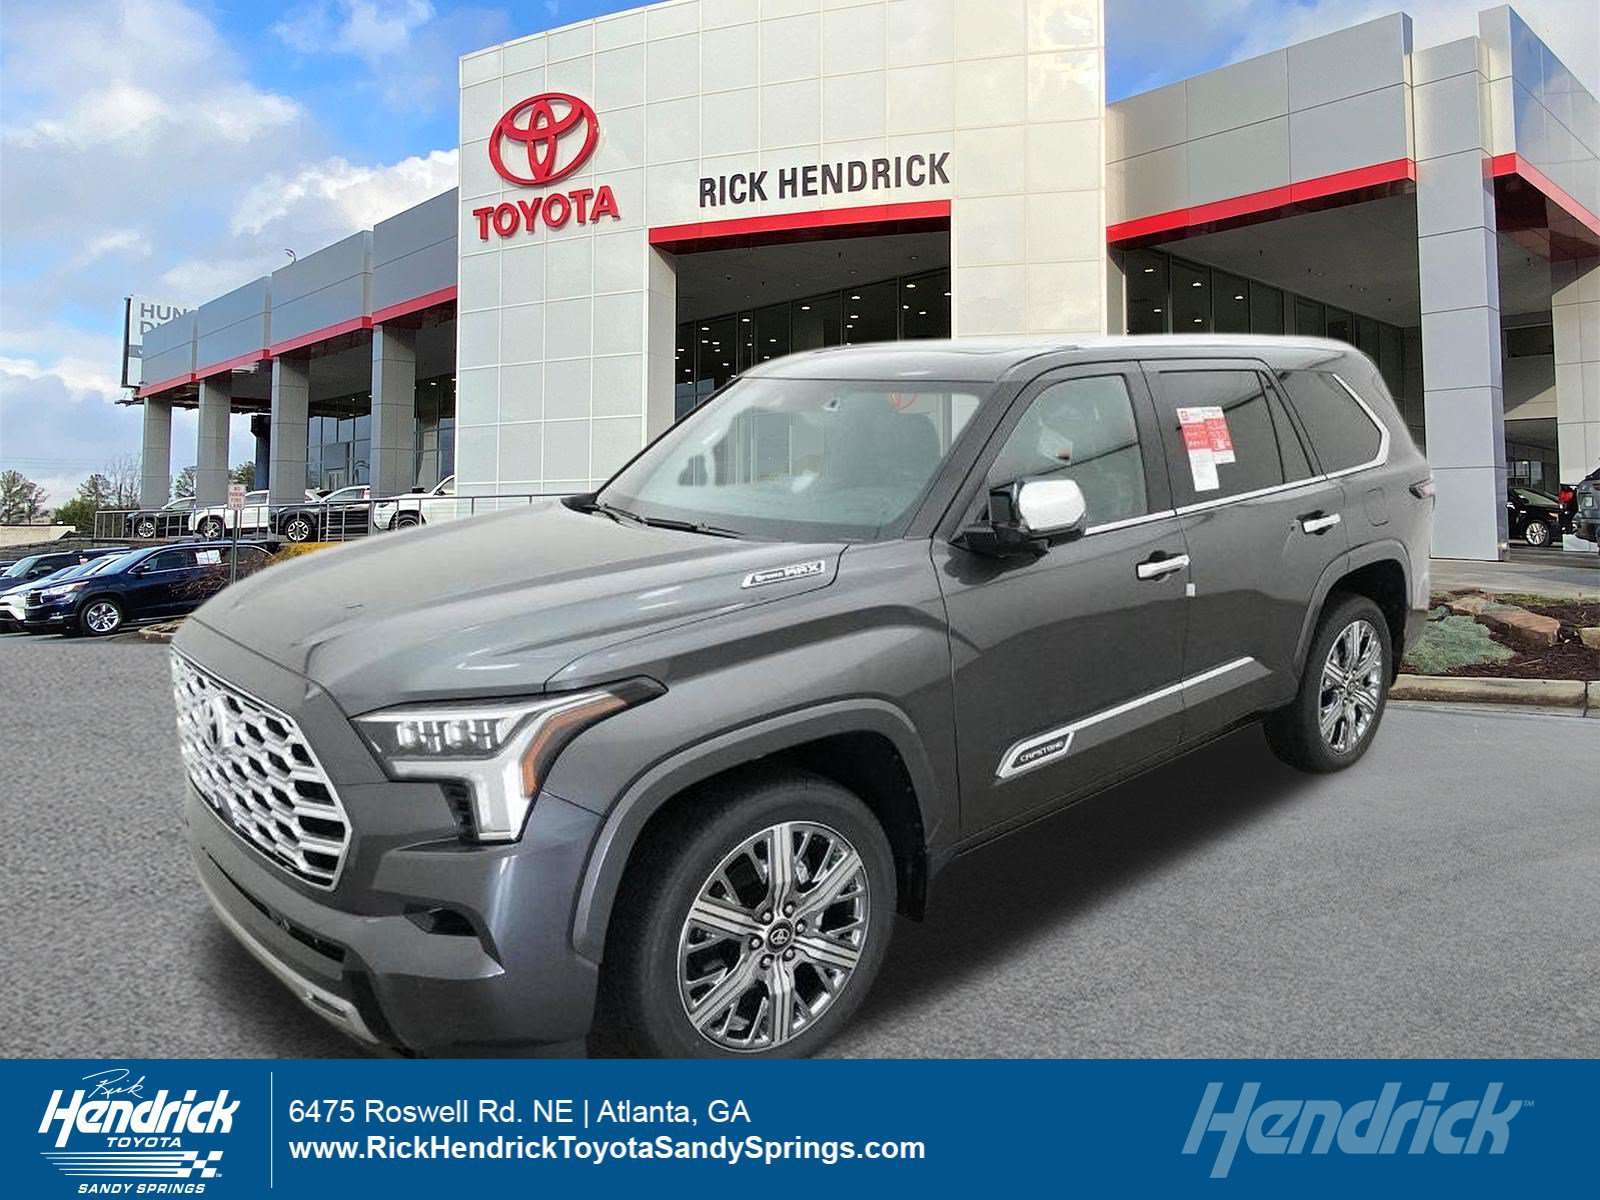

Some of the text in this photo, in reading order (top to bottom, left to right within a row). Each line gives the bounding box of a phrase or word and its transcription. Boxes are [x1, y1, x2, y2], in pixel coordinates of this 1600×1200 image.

[699, 152, 951, 208] RICK HENDRICK
[473, 185, 621, 241] TOYOTA
